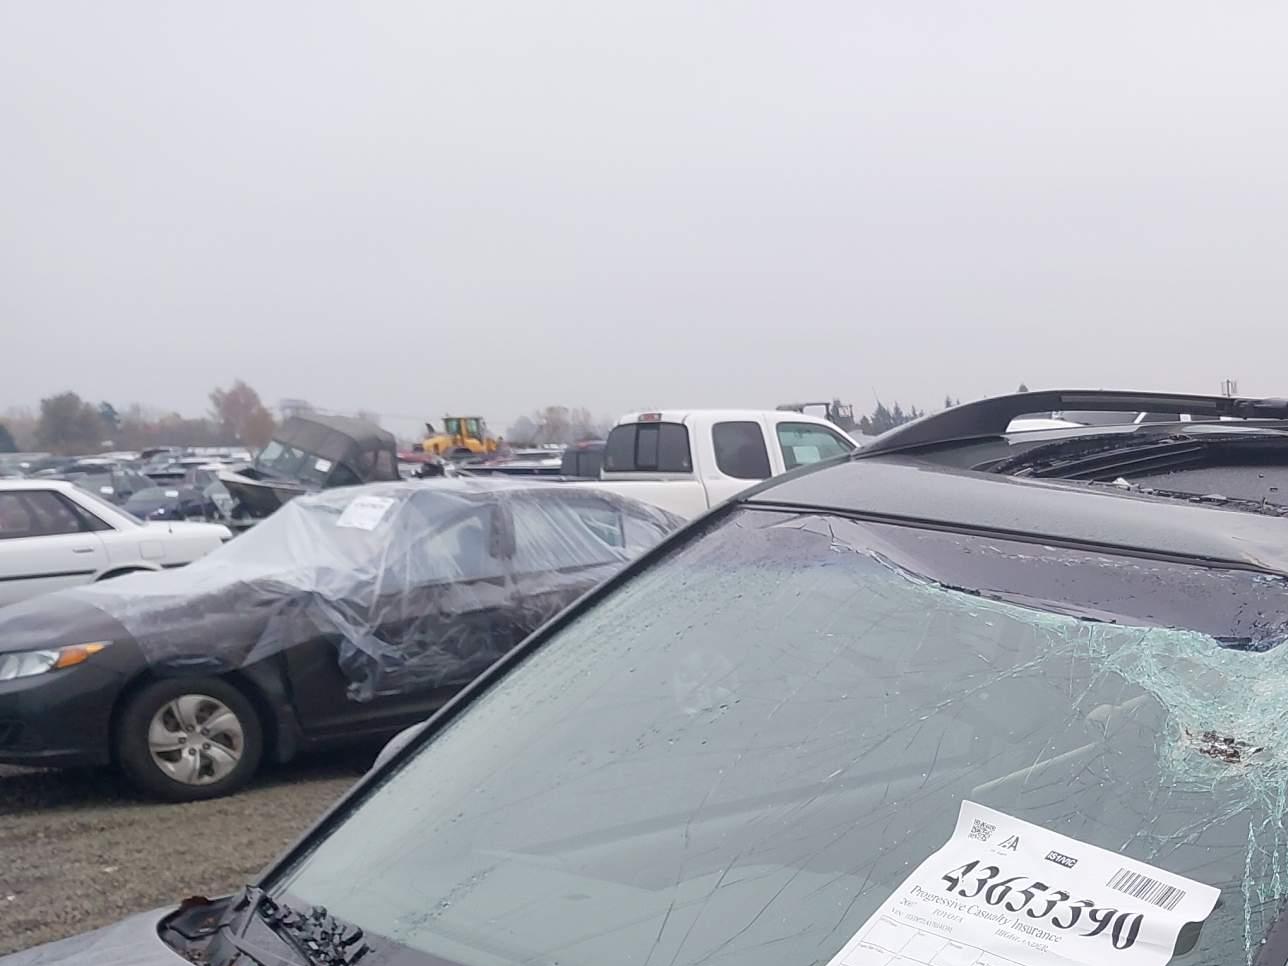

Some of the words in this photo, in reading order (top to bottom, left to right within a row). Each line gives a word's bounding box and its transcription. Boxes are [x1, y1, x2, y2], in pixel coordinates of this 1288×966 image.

[910, 885, 966, 911] Progressive
[966, 904, 1011, 926] Casualty
[1010, 918, 1063, 943] Insurance
[942, 860, 1144, 949] 43653390
